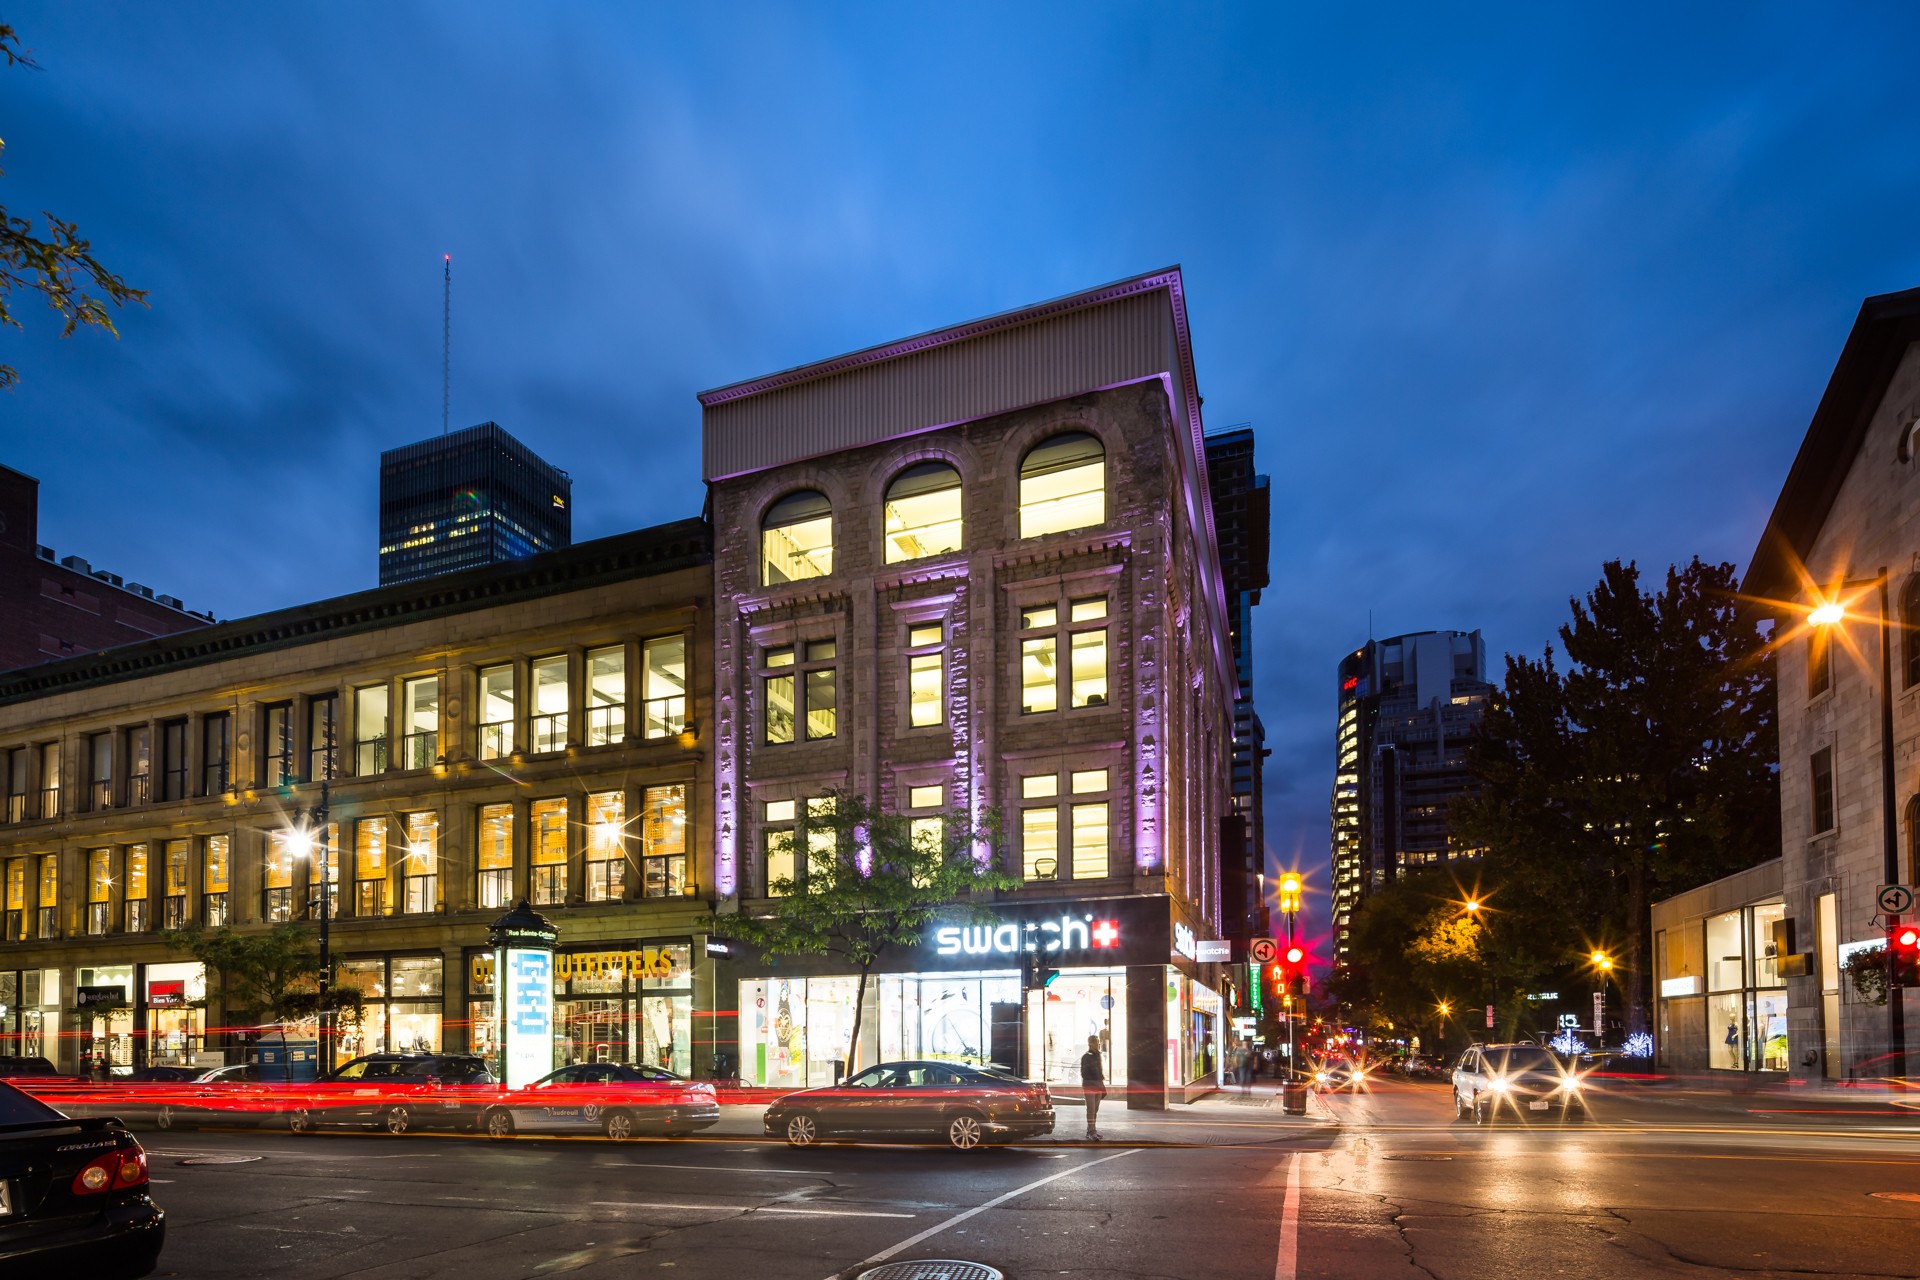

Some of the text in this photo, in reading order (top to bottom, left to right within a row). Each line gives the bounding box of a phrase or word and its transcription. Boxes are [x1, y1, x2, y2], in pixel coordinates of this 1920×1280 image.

[554, 949, 673, 982] UTFITTERS
[150, 983, 183, 995] GNC
[56, 1141, 104, 1152] COROLLA
